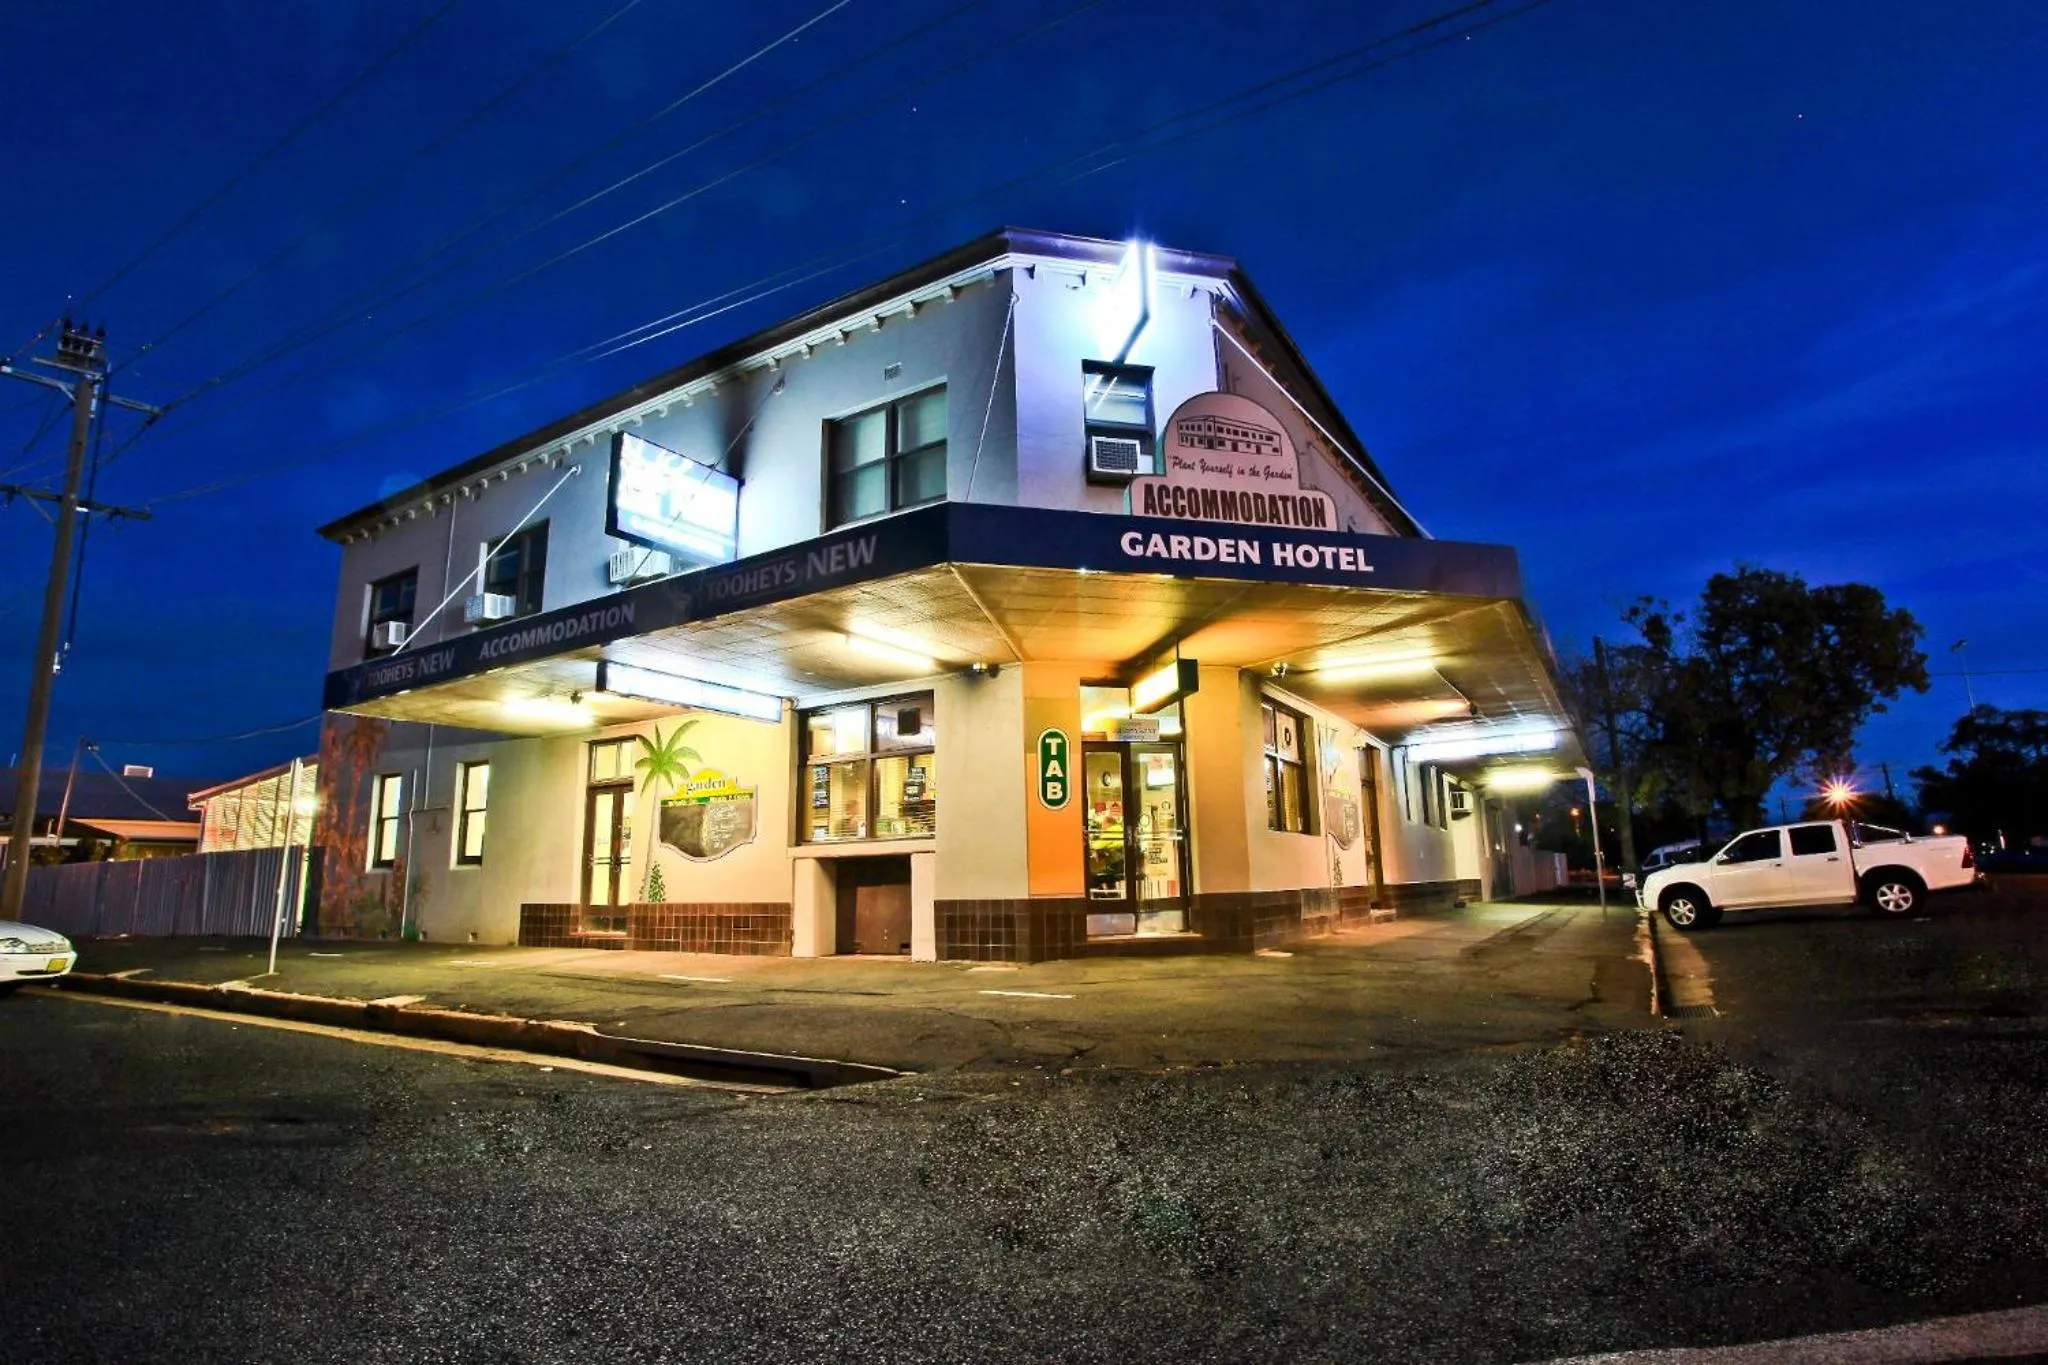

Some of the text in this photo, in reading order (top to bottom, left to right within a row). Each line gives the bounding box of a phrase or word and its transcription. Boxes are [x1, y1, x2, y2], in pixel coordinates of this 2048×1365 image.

[1199, 458, 1234, 478] Yourself
[1236, 465, 1246, 475] in
[1248, 465, 1260, 477] the
[1143, 483, 1327, 528] ACCOMMODATION
[706, 536, 876, 602] TOOHEYS NEW
[1120, 531, 1374, 572] GARDEN HOTEL
[479, 601, 635, 660] ACCOMMODATION
[367, 648, 455, 687] TOOHEYS NEW
[1045, 737, 1064, 800] TAB
